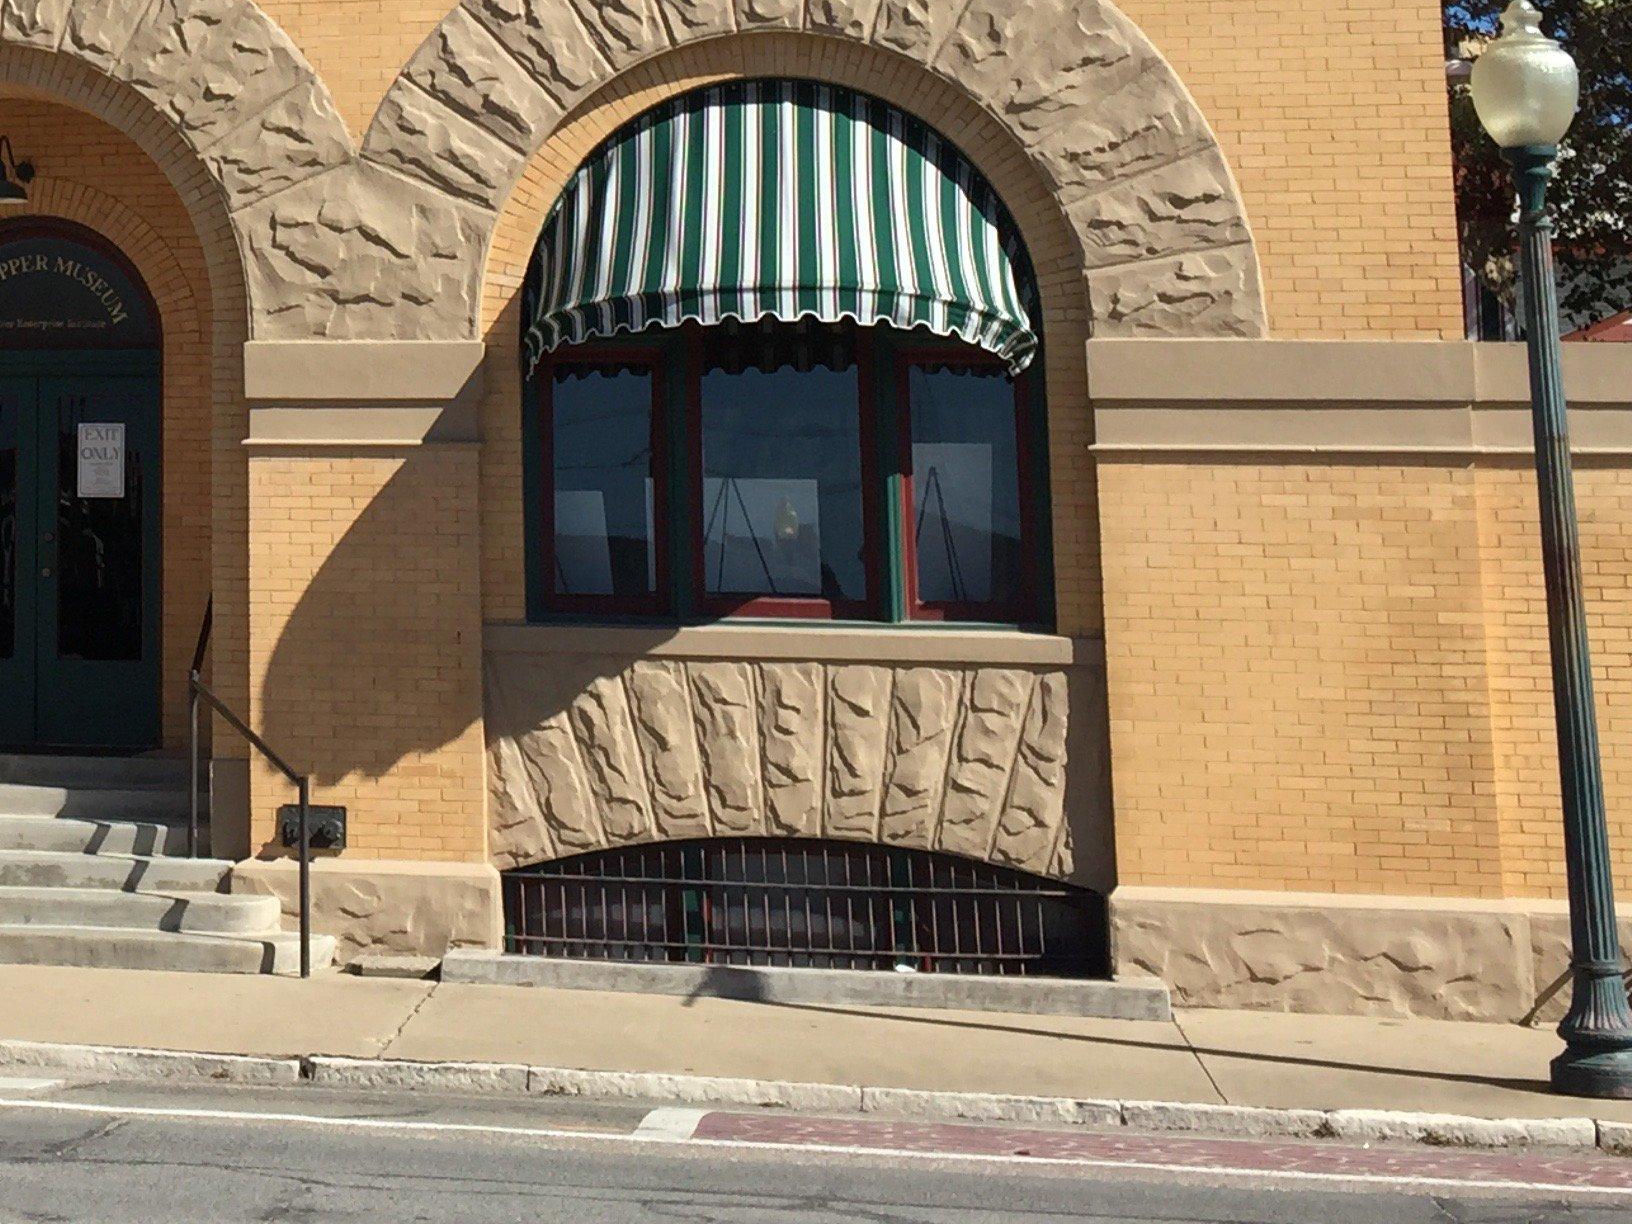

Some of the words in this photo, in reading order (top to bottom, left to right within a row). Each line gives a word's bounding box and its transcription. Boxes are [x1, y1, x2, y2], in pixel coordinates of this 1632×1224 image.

[54, 256, 129, 325] MUSEUM
[84, 427, 119, 441] EXIT
[81, 446, 120, 460] ONLY
